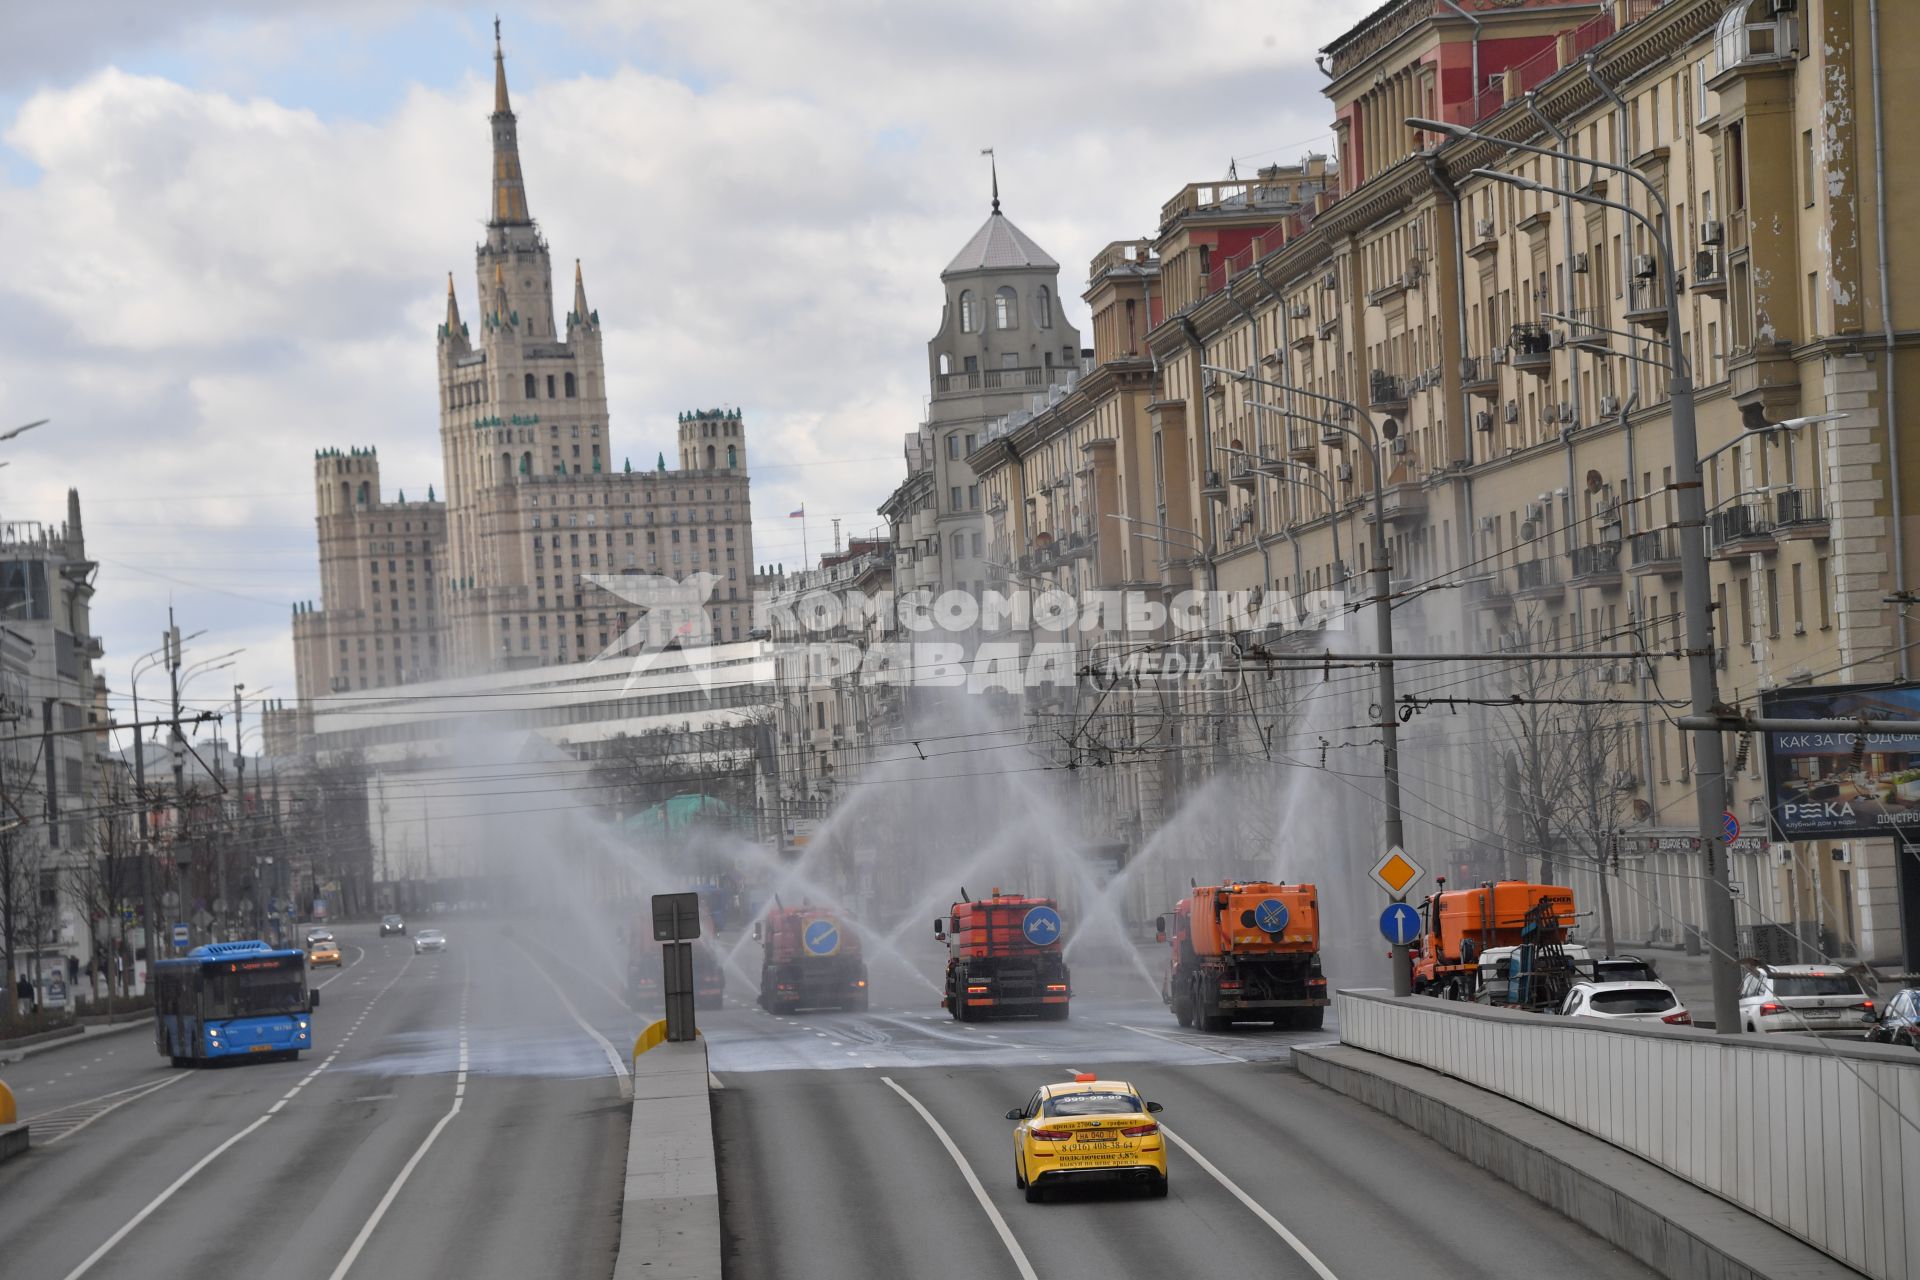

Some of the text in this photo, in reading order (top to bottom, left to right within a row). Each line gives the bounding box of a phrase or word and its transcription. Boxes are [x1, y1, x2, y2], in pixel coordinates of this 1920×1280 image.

[1780, 735, 1811, 749] КАК
[1814, 735, 1834, 746] ЗА
[1877, 812, 1920, 824] ДОНСТРО
[1069, 1143, 1090, 1151] (916)
